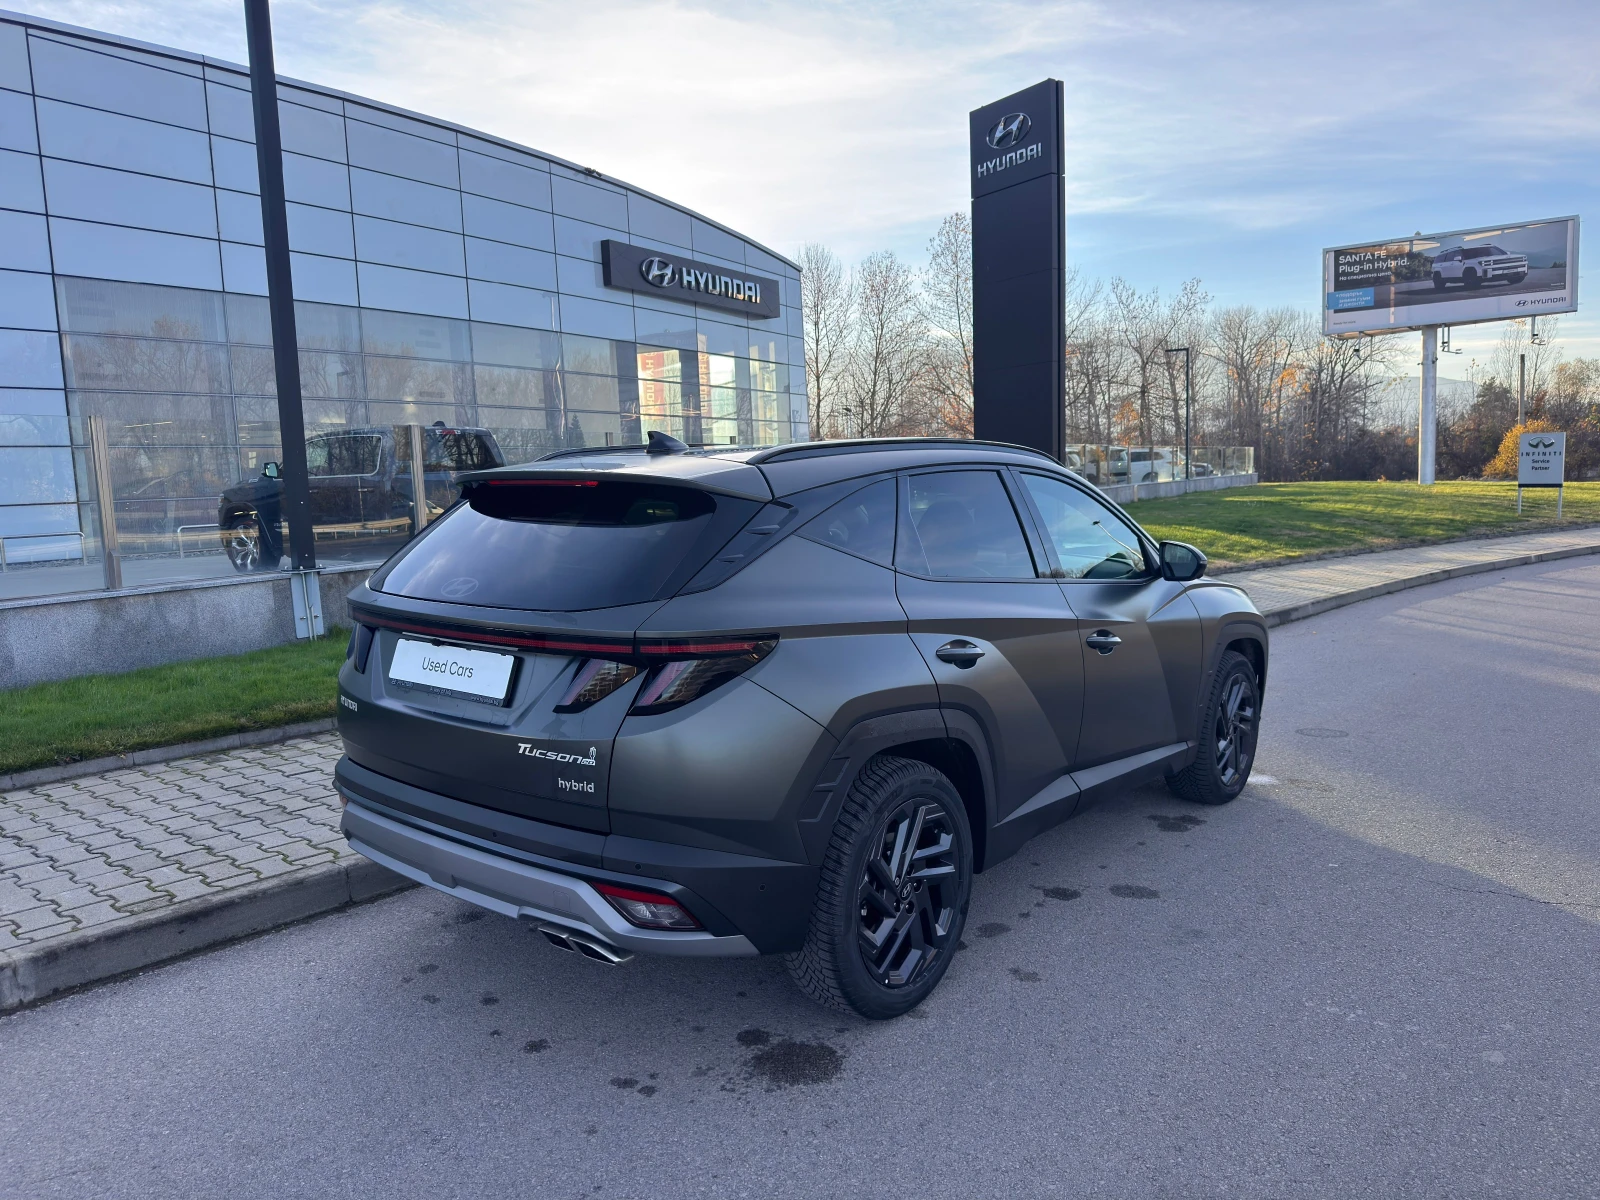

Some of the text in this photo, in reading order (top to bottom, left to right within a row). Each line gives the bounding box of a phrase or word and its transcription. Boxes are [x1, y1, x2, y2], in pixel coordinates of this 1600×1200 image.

[977, 142, 1042, 178] HYUNDAI
[1339, 252, 1373, 264] SANTA
[1339, 257, 1410, 273] Plug-in Hybrid.
[681, 267, 761, 304] HYUNDAI
[1530, 296, 1567, 305] HYUNDAI
[422, 656, 474, 678] Used Cars
[558, 777, 595, 793] hybrid
